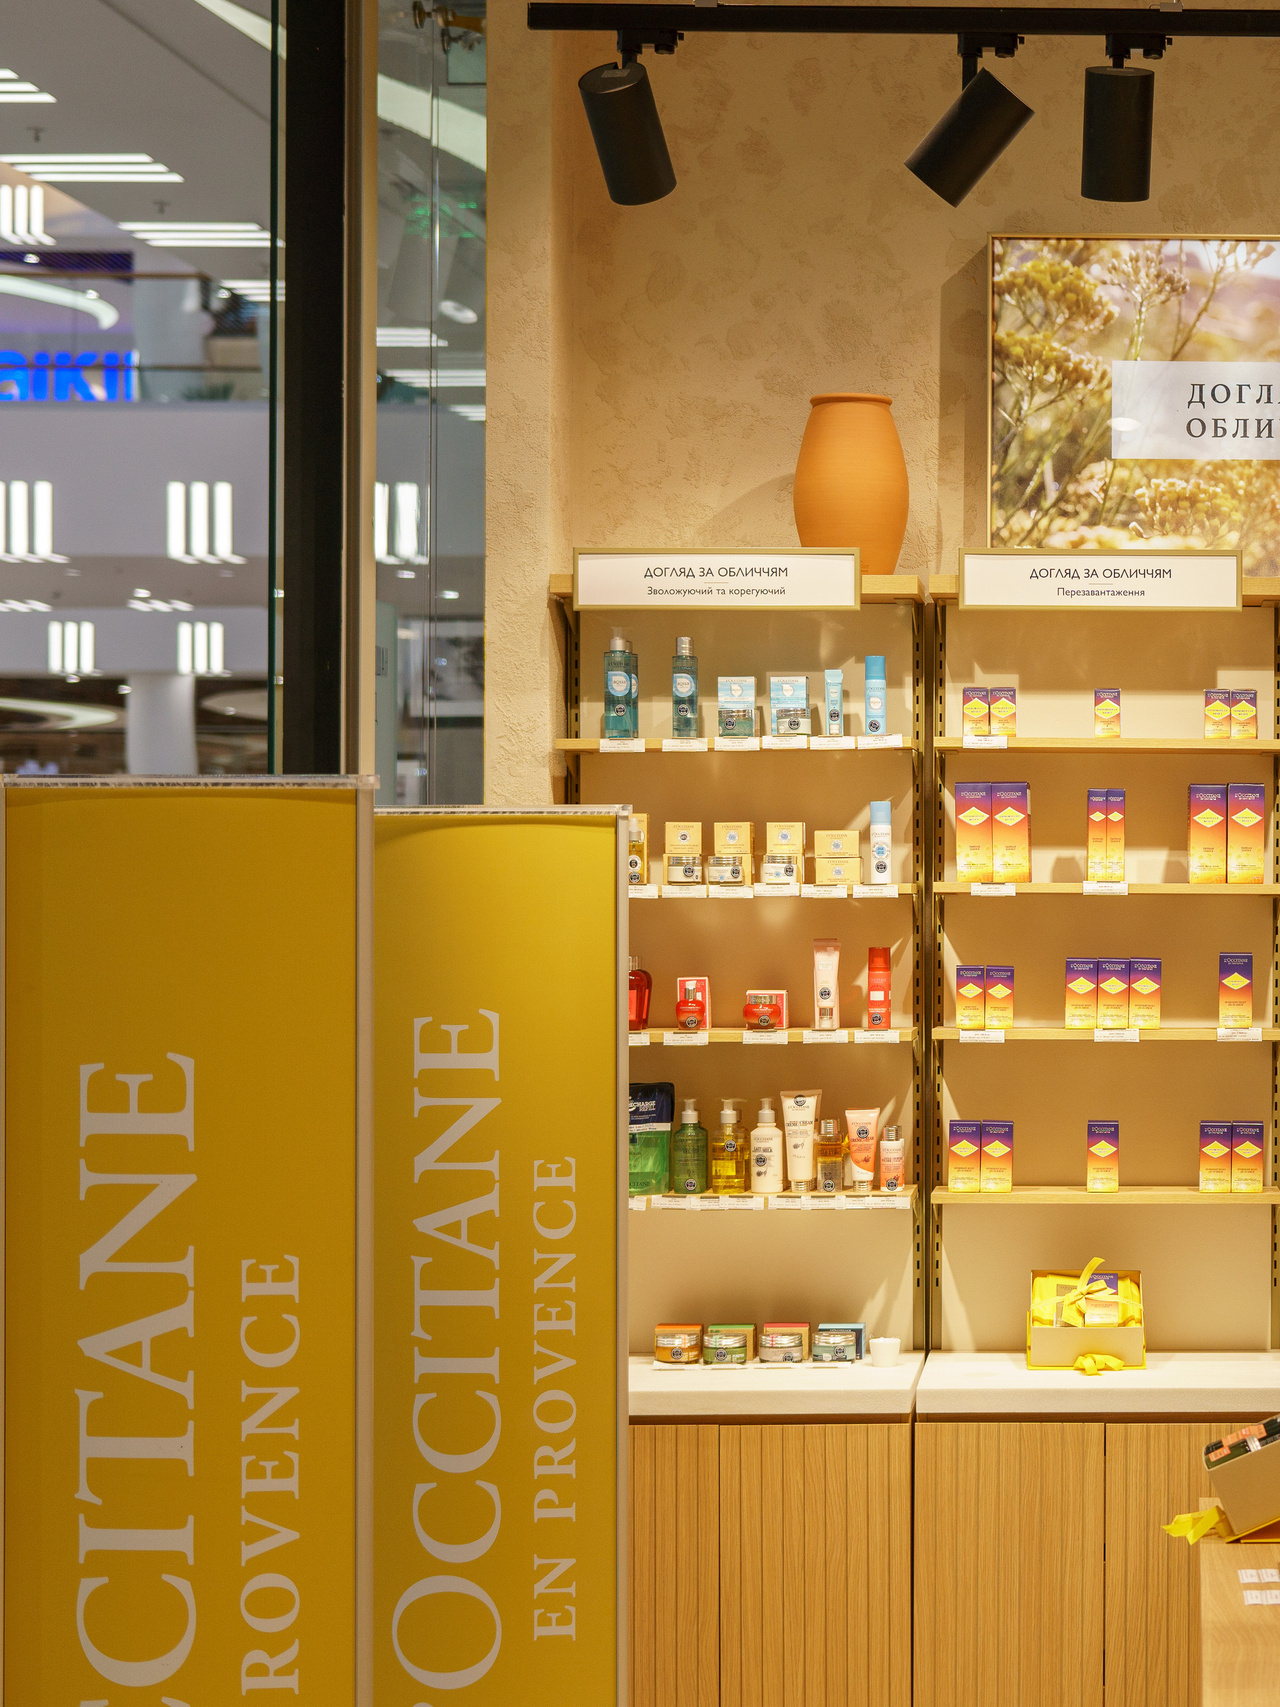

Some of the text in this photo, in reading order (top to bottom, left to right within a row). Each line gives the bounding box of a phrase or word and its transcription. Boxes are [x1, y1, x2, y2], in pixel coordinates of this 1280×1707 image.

[643, 566, 789, 579] ДОГЛЯД ЗА ОБЛИЧЧЯМ
[1029, 567, 1172, 580] ДОГЛЯД ЗА ОБЛИЧЧЯМ
[647, 586, 786, 598] Зволожуючий та корегуючий
[1057, 587, 1146, 599] Перезавантаження
[391, 1008, 502, 1707] OCCITANE
[74, 1051, 198, 1707] CITANE
[533, 1155, 577, 1642] EN PROVENCE
